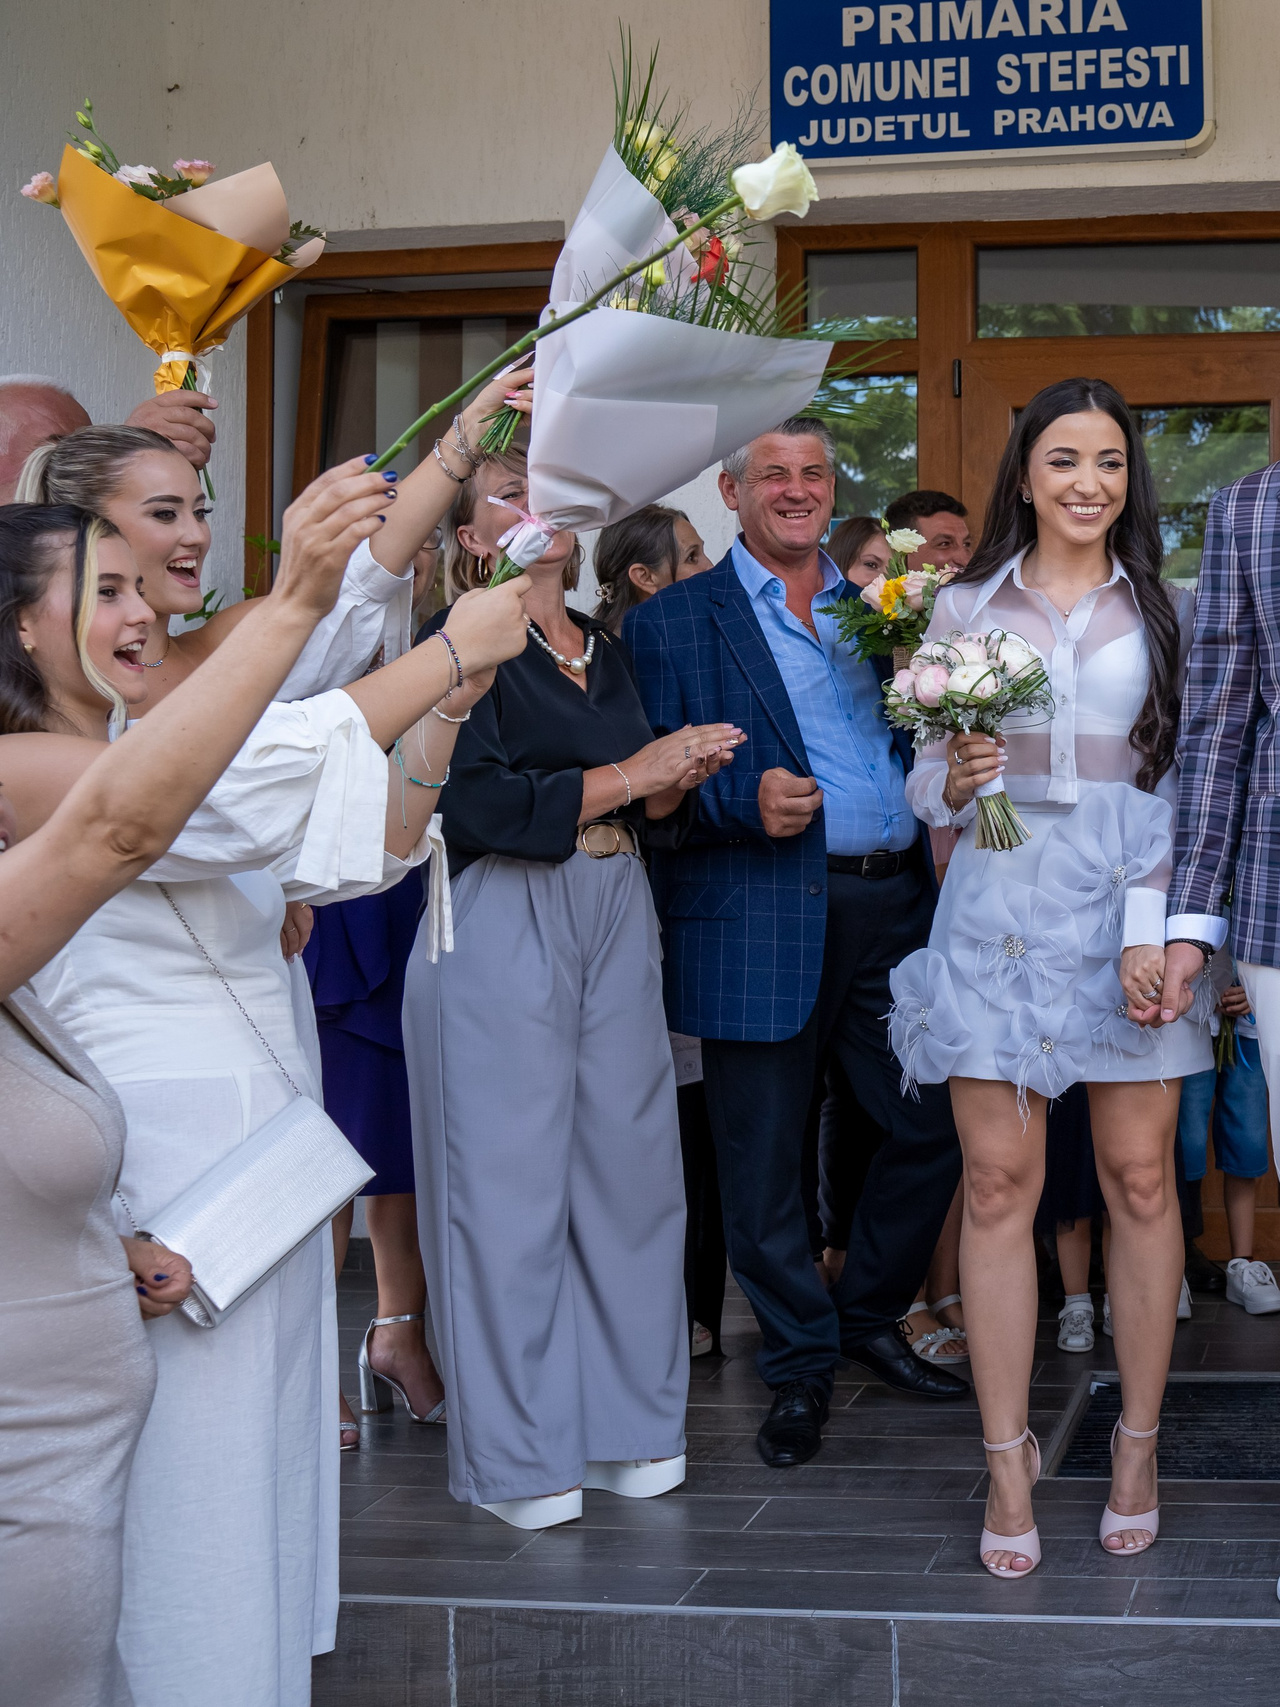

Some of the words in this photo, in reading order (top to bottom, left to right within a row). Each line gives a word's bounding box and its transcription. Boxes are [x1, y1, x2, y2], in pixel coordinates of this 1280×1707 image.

[842, 0, 1128, 47] PRIMARIA
[783, 56, 970, 107] COMUNEI
[996, 44, 1190, 95] STEFESTI
[798, 111, 971, 146] JUDETUL
[994, 101, 1175, 136] PRAHOVA
